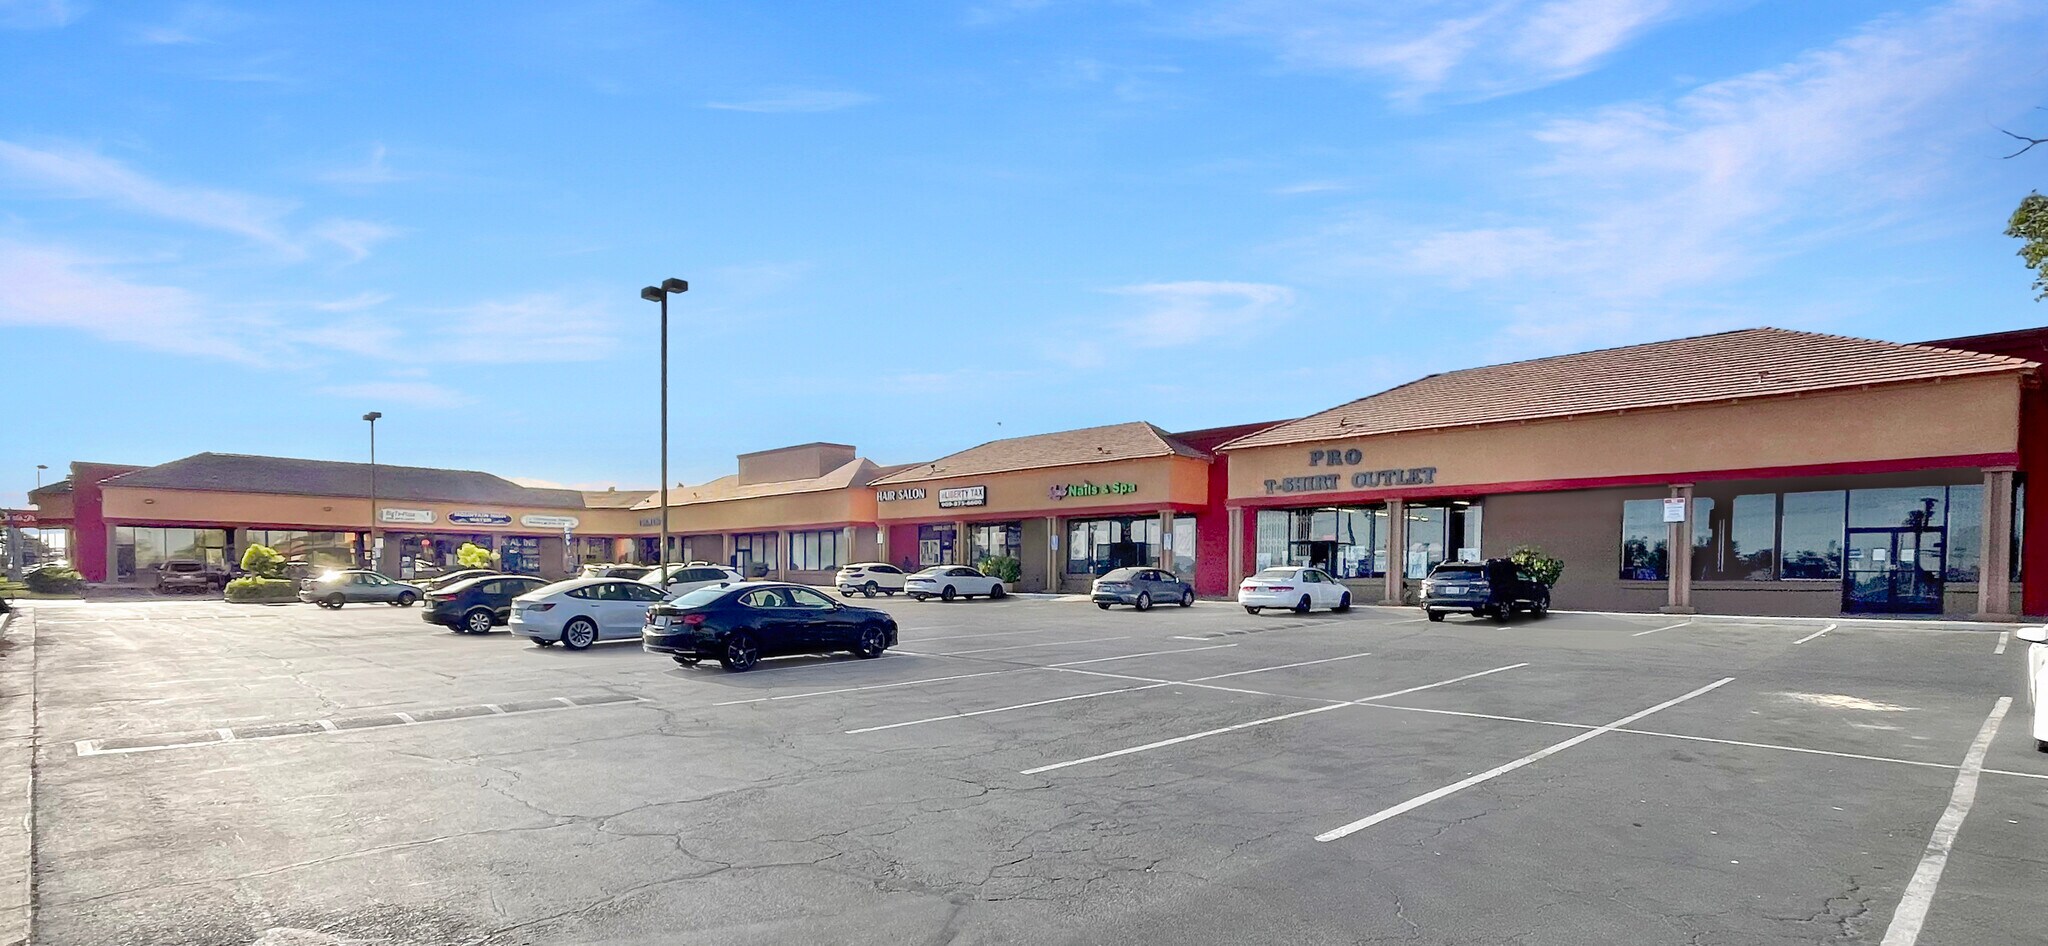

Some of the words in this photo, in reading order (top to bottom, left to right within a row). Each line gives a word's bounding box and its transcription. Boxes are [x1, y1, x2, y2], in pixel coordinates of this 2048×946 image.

[1309, 448, 1363, 466] PRO
[1264, 474, 1341, 494] T-SHIRT
[1351, 467, 1437, 488] OUTLET
[877, 490, 897, 502] HAIR
[898, 488, 926, 500] SALON
[944, 489, 969, 499] LIBERTY
[971, 488, 983, 497] TAX
[1068, 483, 1099, 497] Nails
[1101, 484, 1110, 494] &
[1112, 482, 1137, 495] Spa
